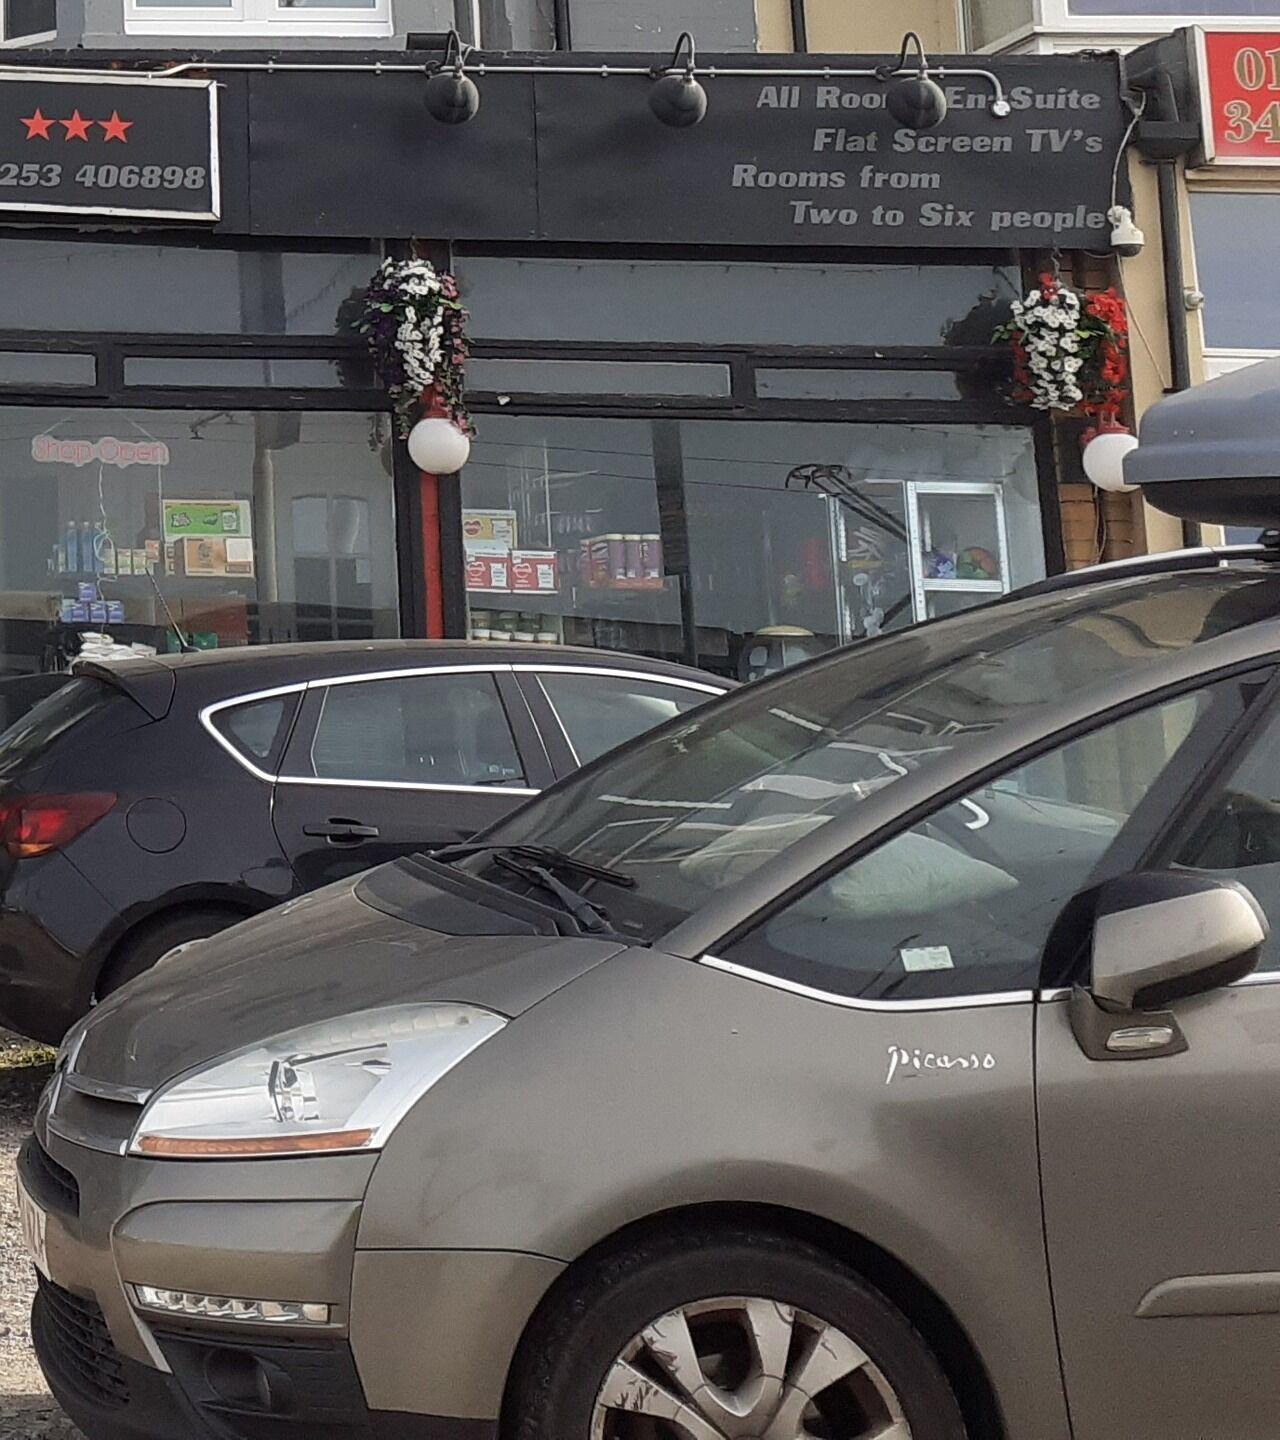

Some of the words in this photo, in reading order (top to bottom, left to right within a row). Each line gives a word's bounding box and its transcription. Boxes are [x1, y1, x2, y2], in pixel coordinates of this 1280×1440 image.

[756, 86, 800, 109] All
[813, 128, 879, 153] Flat
[893, 128, 1013, 153] Screen
[1026, 129, 1103, 153] TV's
[75, 164, 206, 190] 406898
[732, 164, 846, 189] Rooms
[860, 165, 941, 189] from
[790, 200, 858, 226] Two
[872, 205, 905, 226] to
[919, 202, 976, 228] Six
[990, 205, 1105, 232] people
